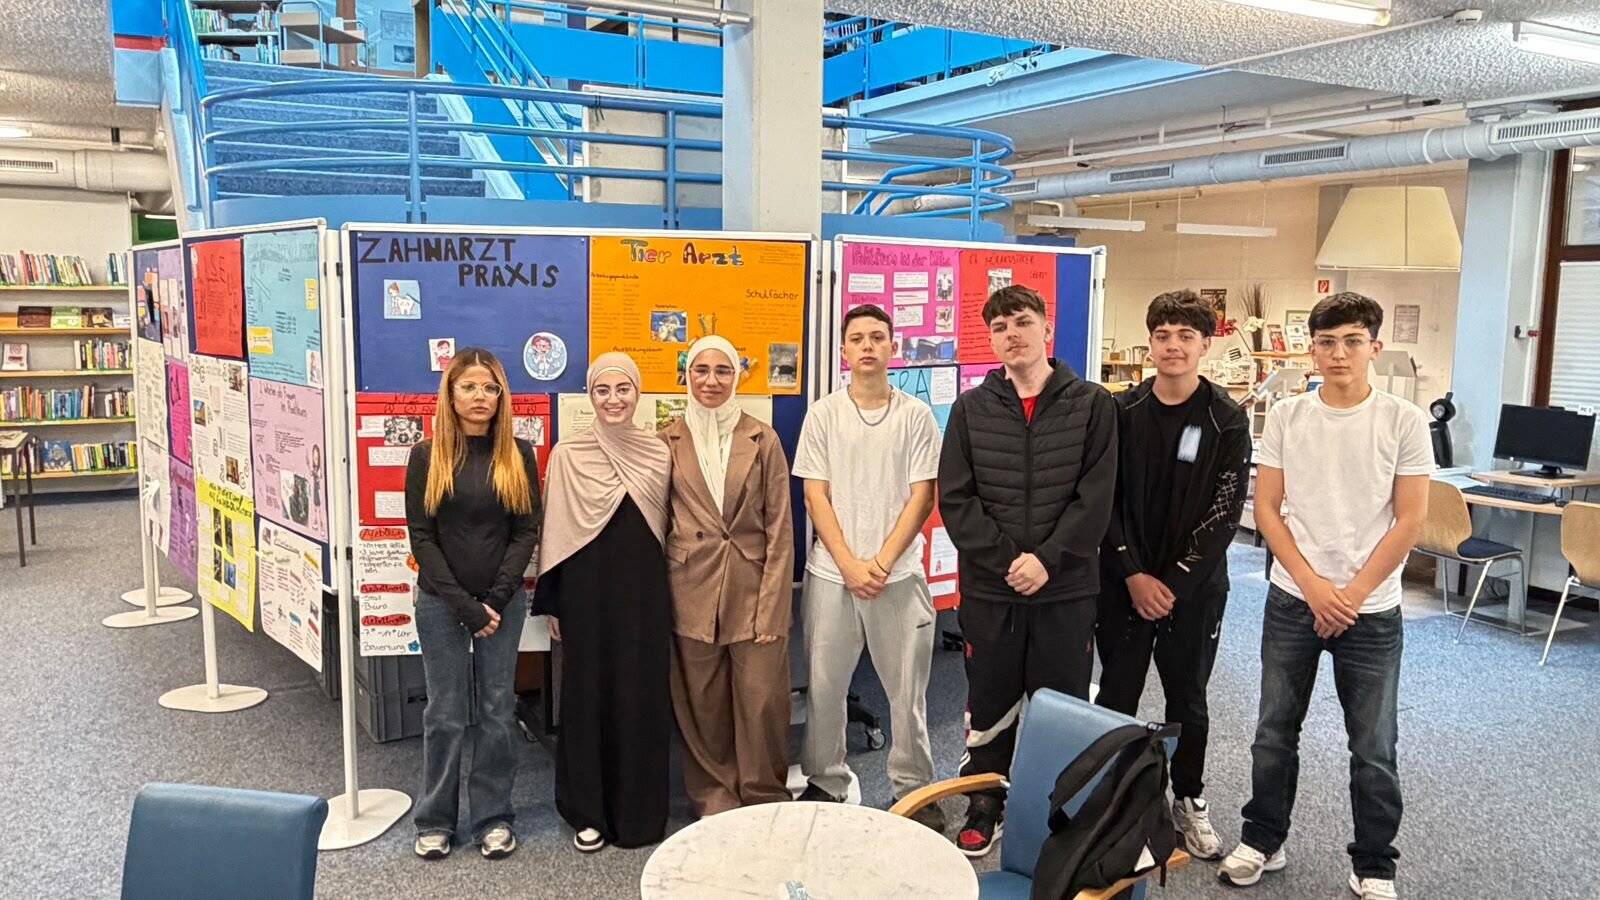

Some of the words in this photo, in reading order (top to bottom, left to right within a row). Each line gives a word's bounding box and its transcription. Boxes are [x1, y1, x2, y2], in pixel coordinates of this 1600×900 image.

[358, 236, 516, 263] ZAHNARZT
[620, 238, 672, 263] Tier
[682, 242, 744, 266] Arzt
[458, 262, 560, 288] PRAXIS
